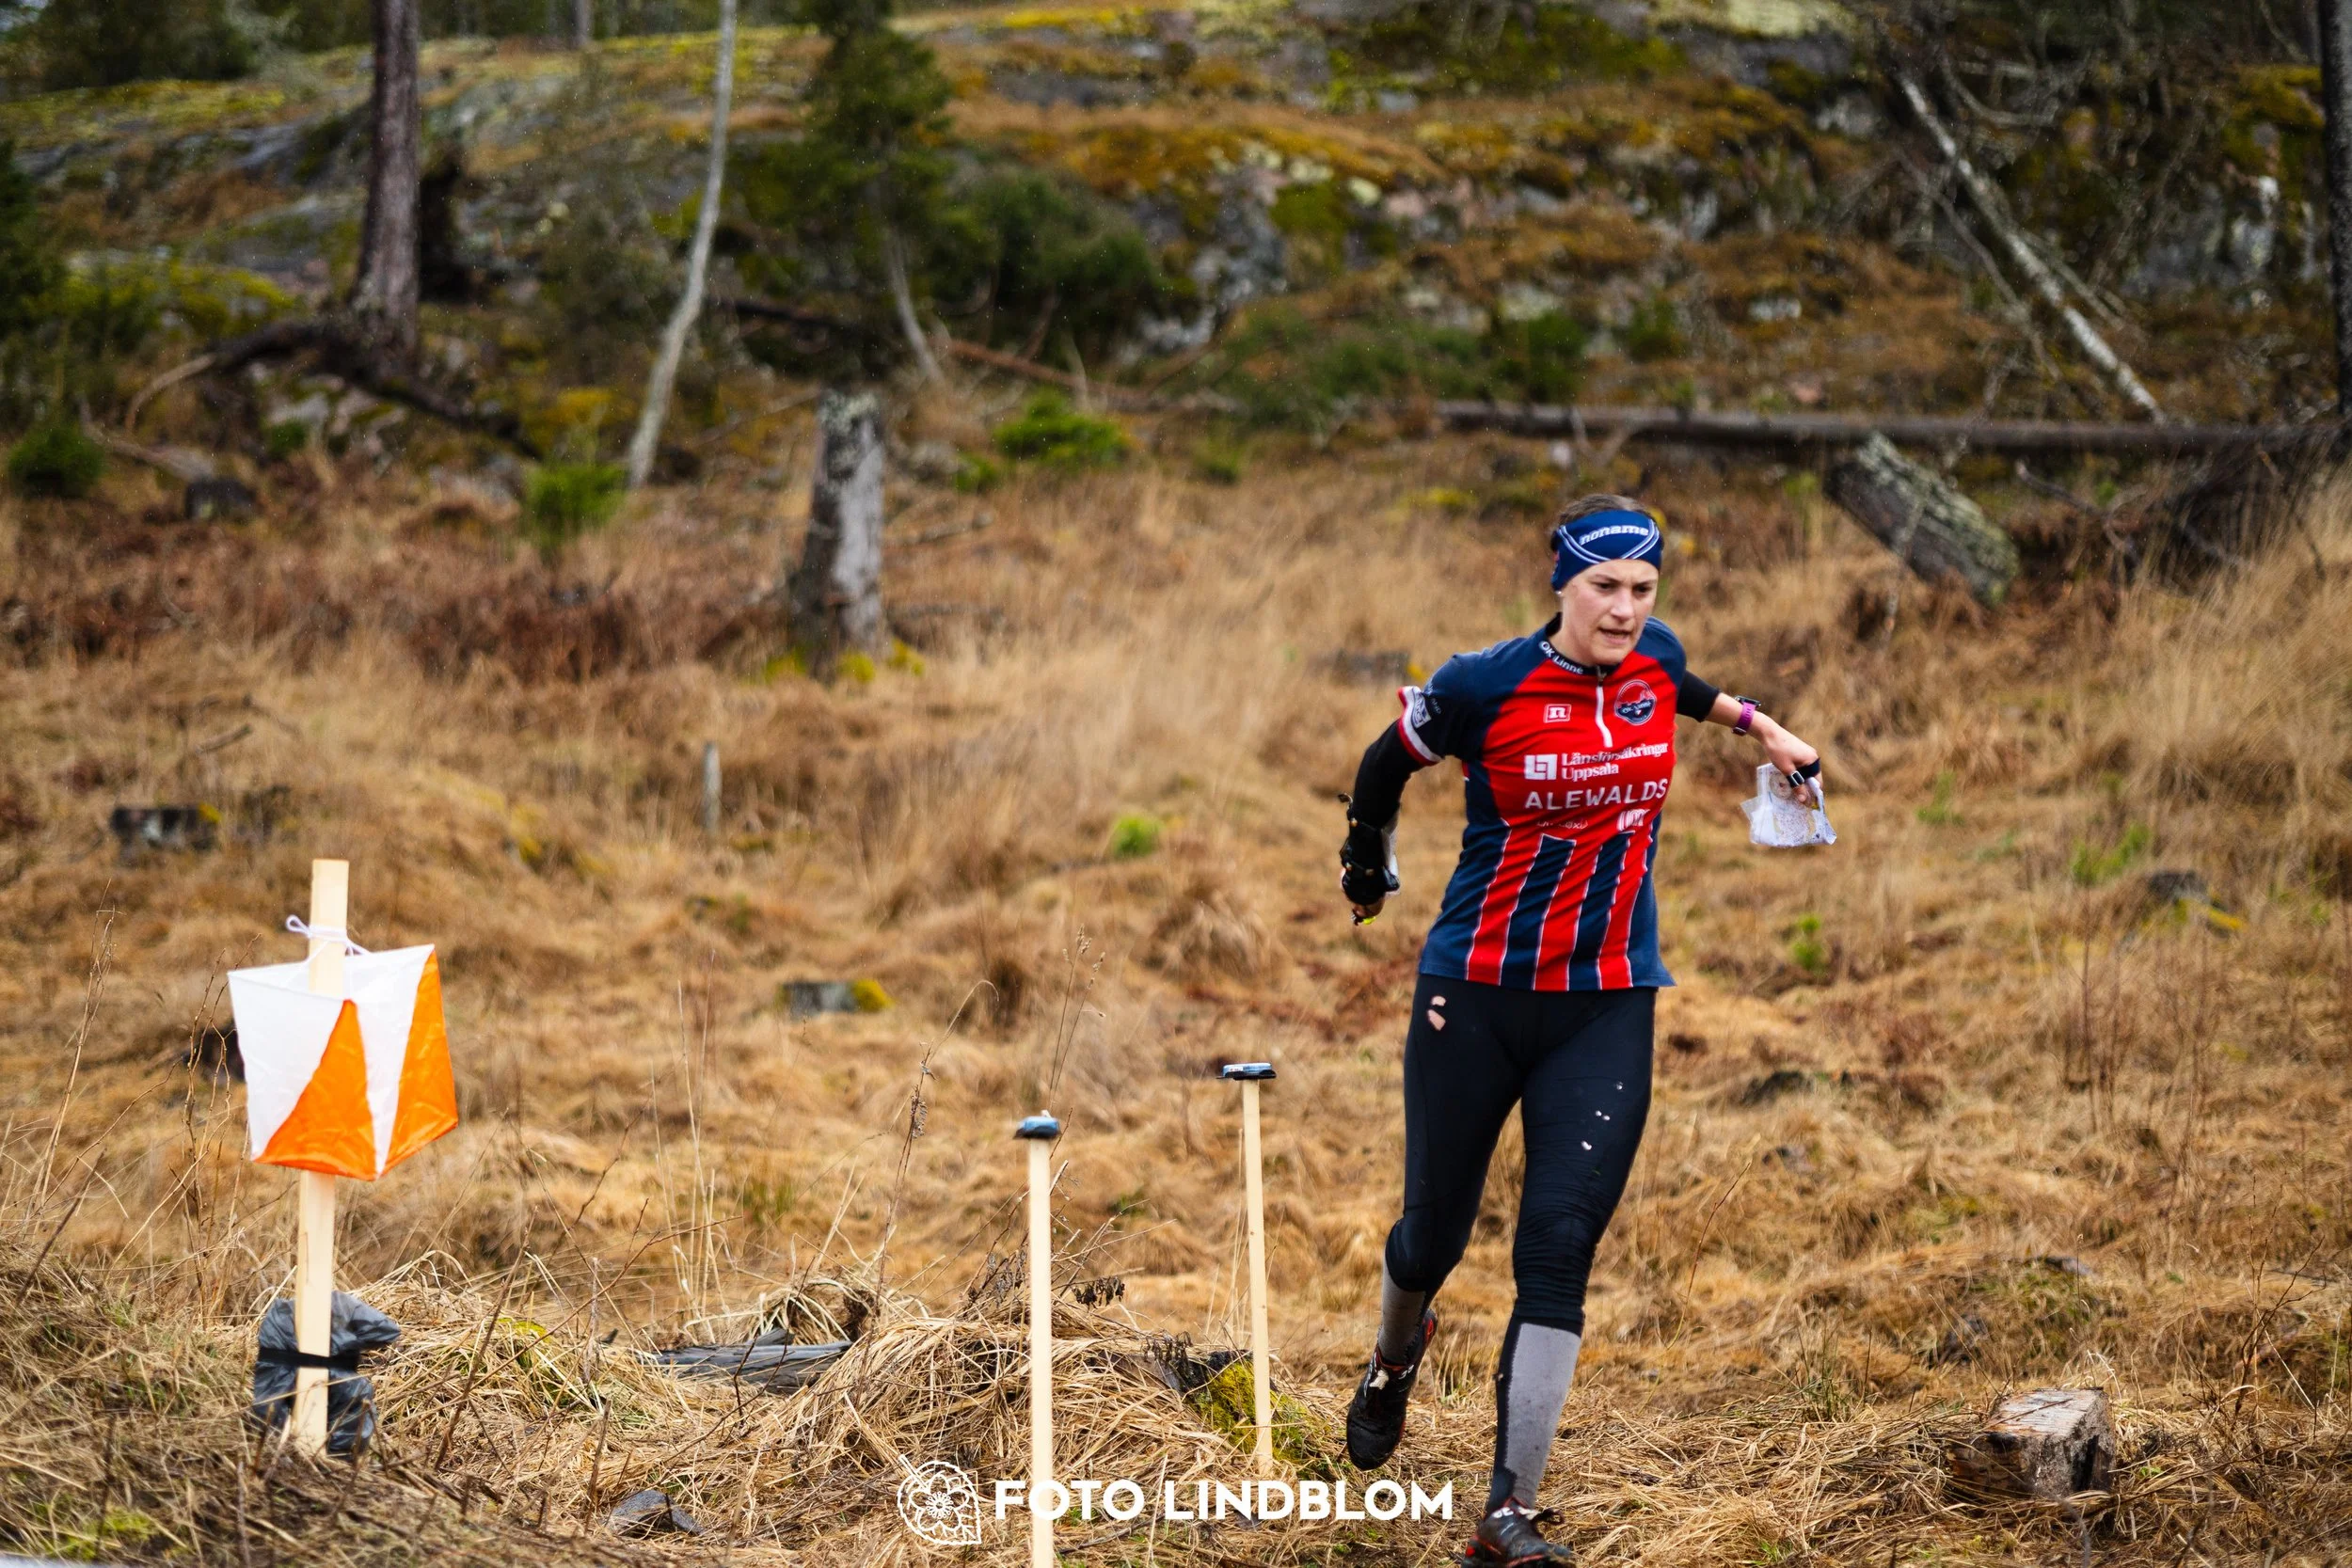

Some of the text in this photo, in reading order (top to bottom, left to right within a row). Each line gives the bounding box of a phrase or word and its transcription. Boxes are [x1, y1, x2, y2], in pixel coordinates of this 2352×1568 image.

[1579, 525, 1649, 546] noname
[1539, 641, 1555, 657] OK
[1562, 762, 1619, 783] Uppsala
[1524, 778, 1668, 810] ALEWALDS
